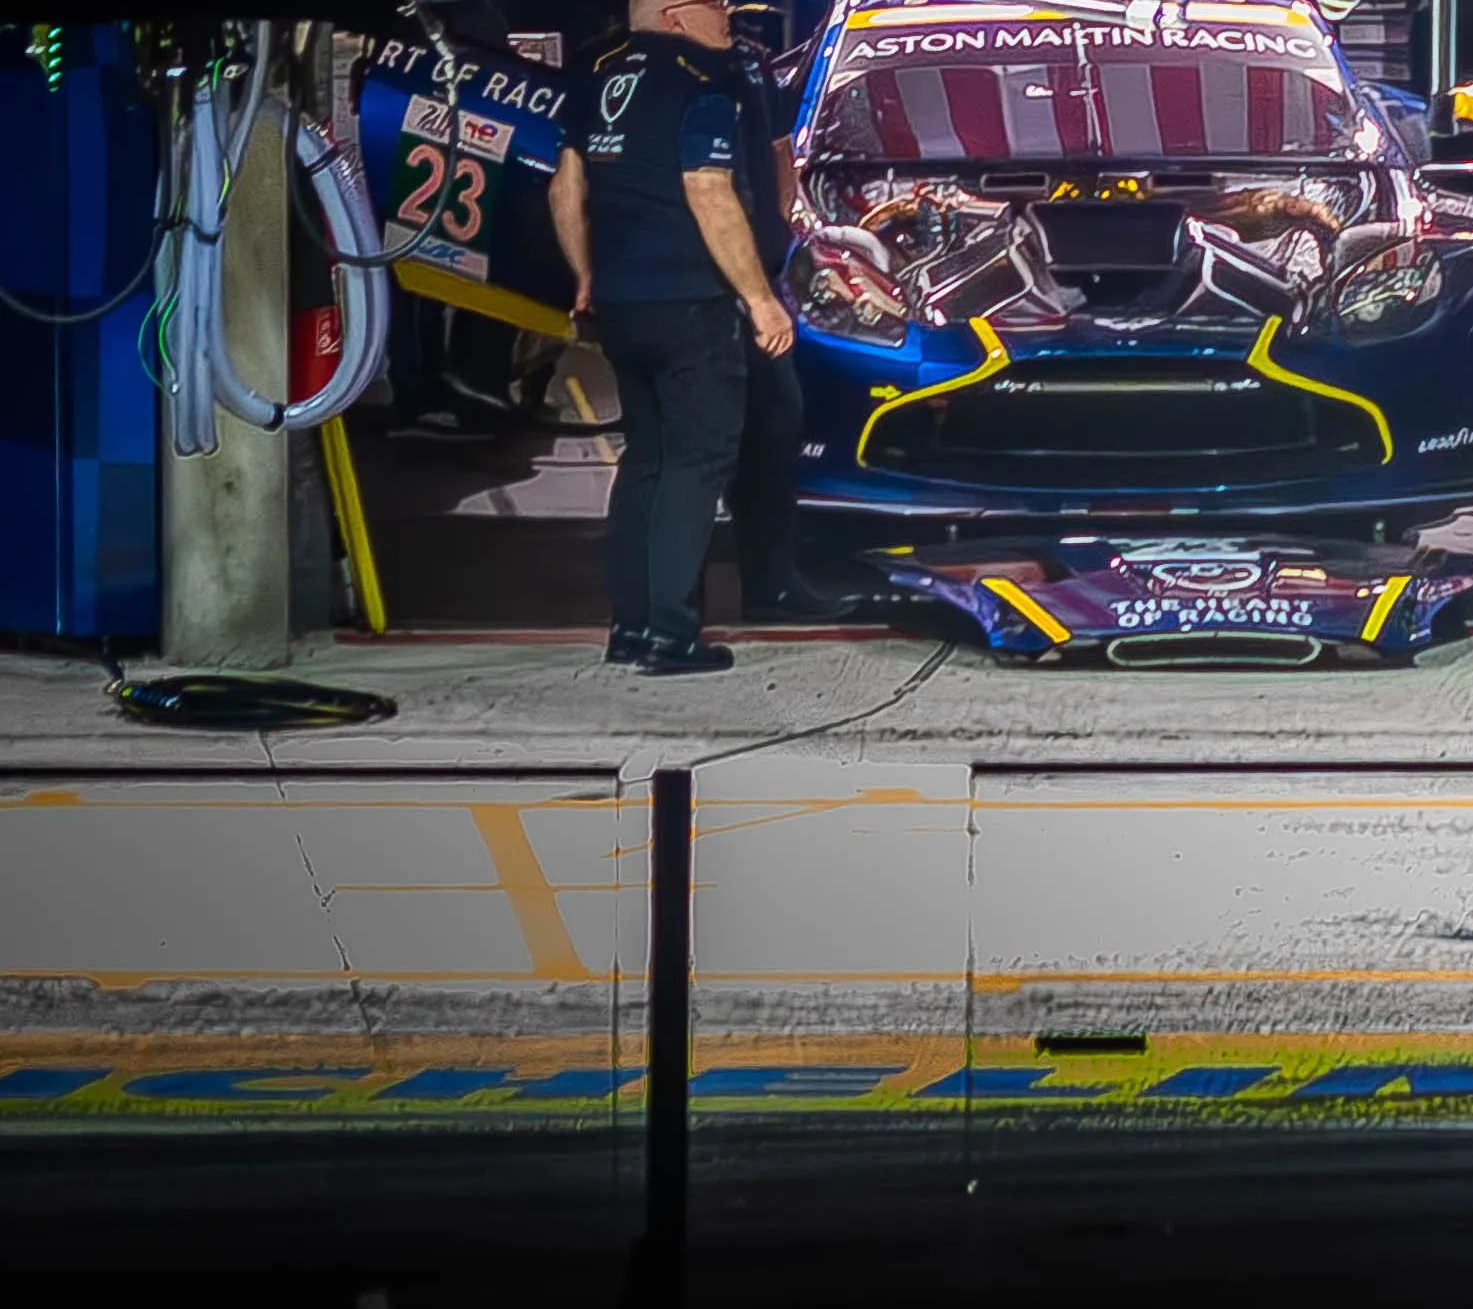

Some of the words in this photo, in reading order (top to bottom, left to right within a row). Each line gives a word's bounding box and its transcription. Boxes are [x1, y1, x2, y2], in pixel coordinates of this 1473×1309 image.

[847, 30, 987, 62] ASTON
[995, 26, 1152, 51] MARTIN
[1158, 29, 1317, 58] RACING
[482, 71, 566, 119] RACI
[397, 143, 486, 243] 23
[1110, 598, 1180, 615] THE
[1195, 596, 1314, 614] HEART
[1118, 610, 1162, 628] OF
[1178, 609, 1313, 627] RACING
